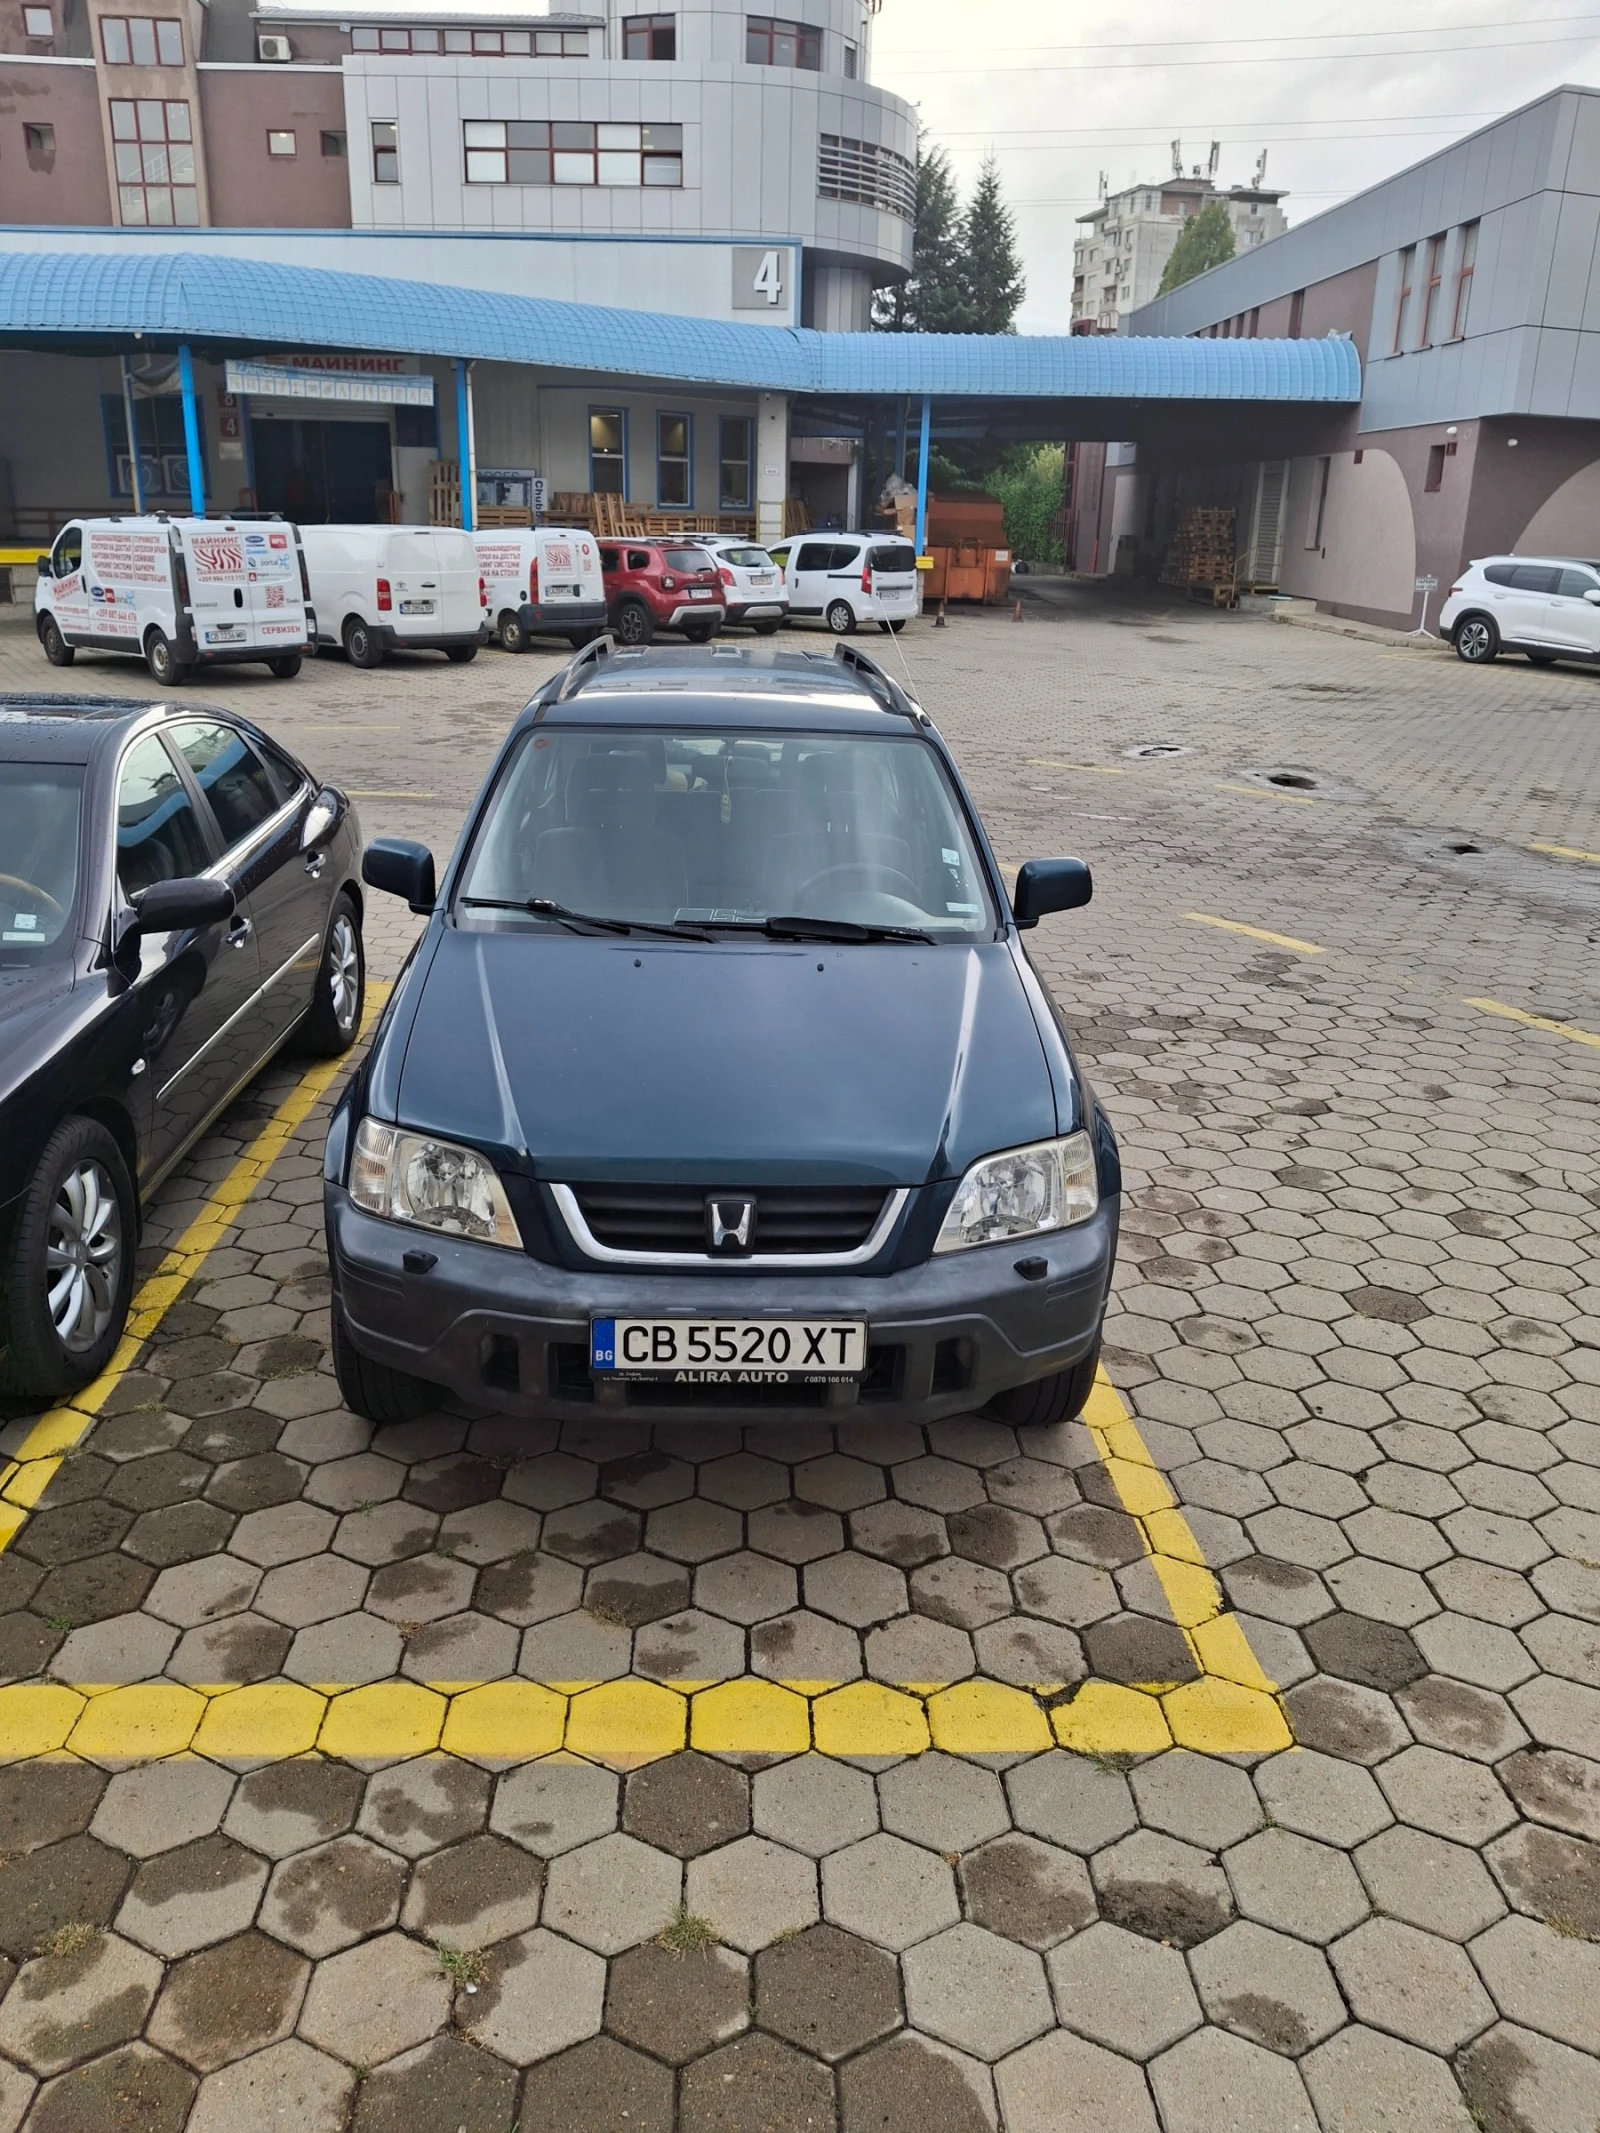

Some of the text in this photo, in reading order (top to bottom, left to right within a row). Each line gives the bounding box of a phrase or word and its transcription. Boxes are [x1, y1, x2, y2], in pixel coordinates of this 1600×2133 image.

[754, 252, 782, 304] 4
[227, 418, 236, 435] 4
[192, 536, 240, 544] МАЙНИНГ
[262, 626, 301, 634] СЕРВИЗЕН
[623, 1326, 856, 1364] CB 5520 XT
[596, 1350, 613, 1361] BG
[674, 1371, 789, 1383] ALIRA AUTO
